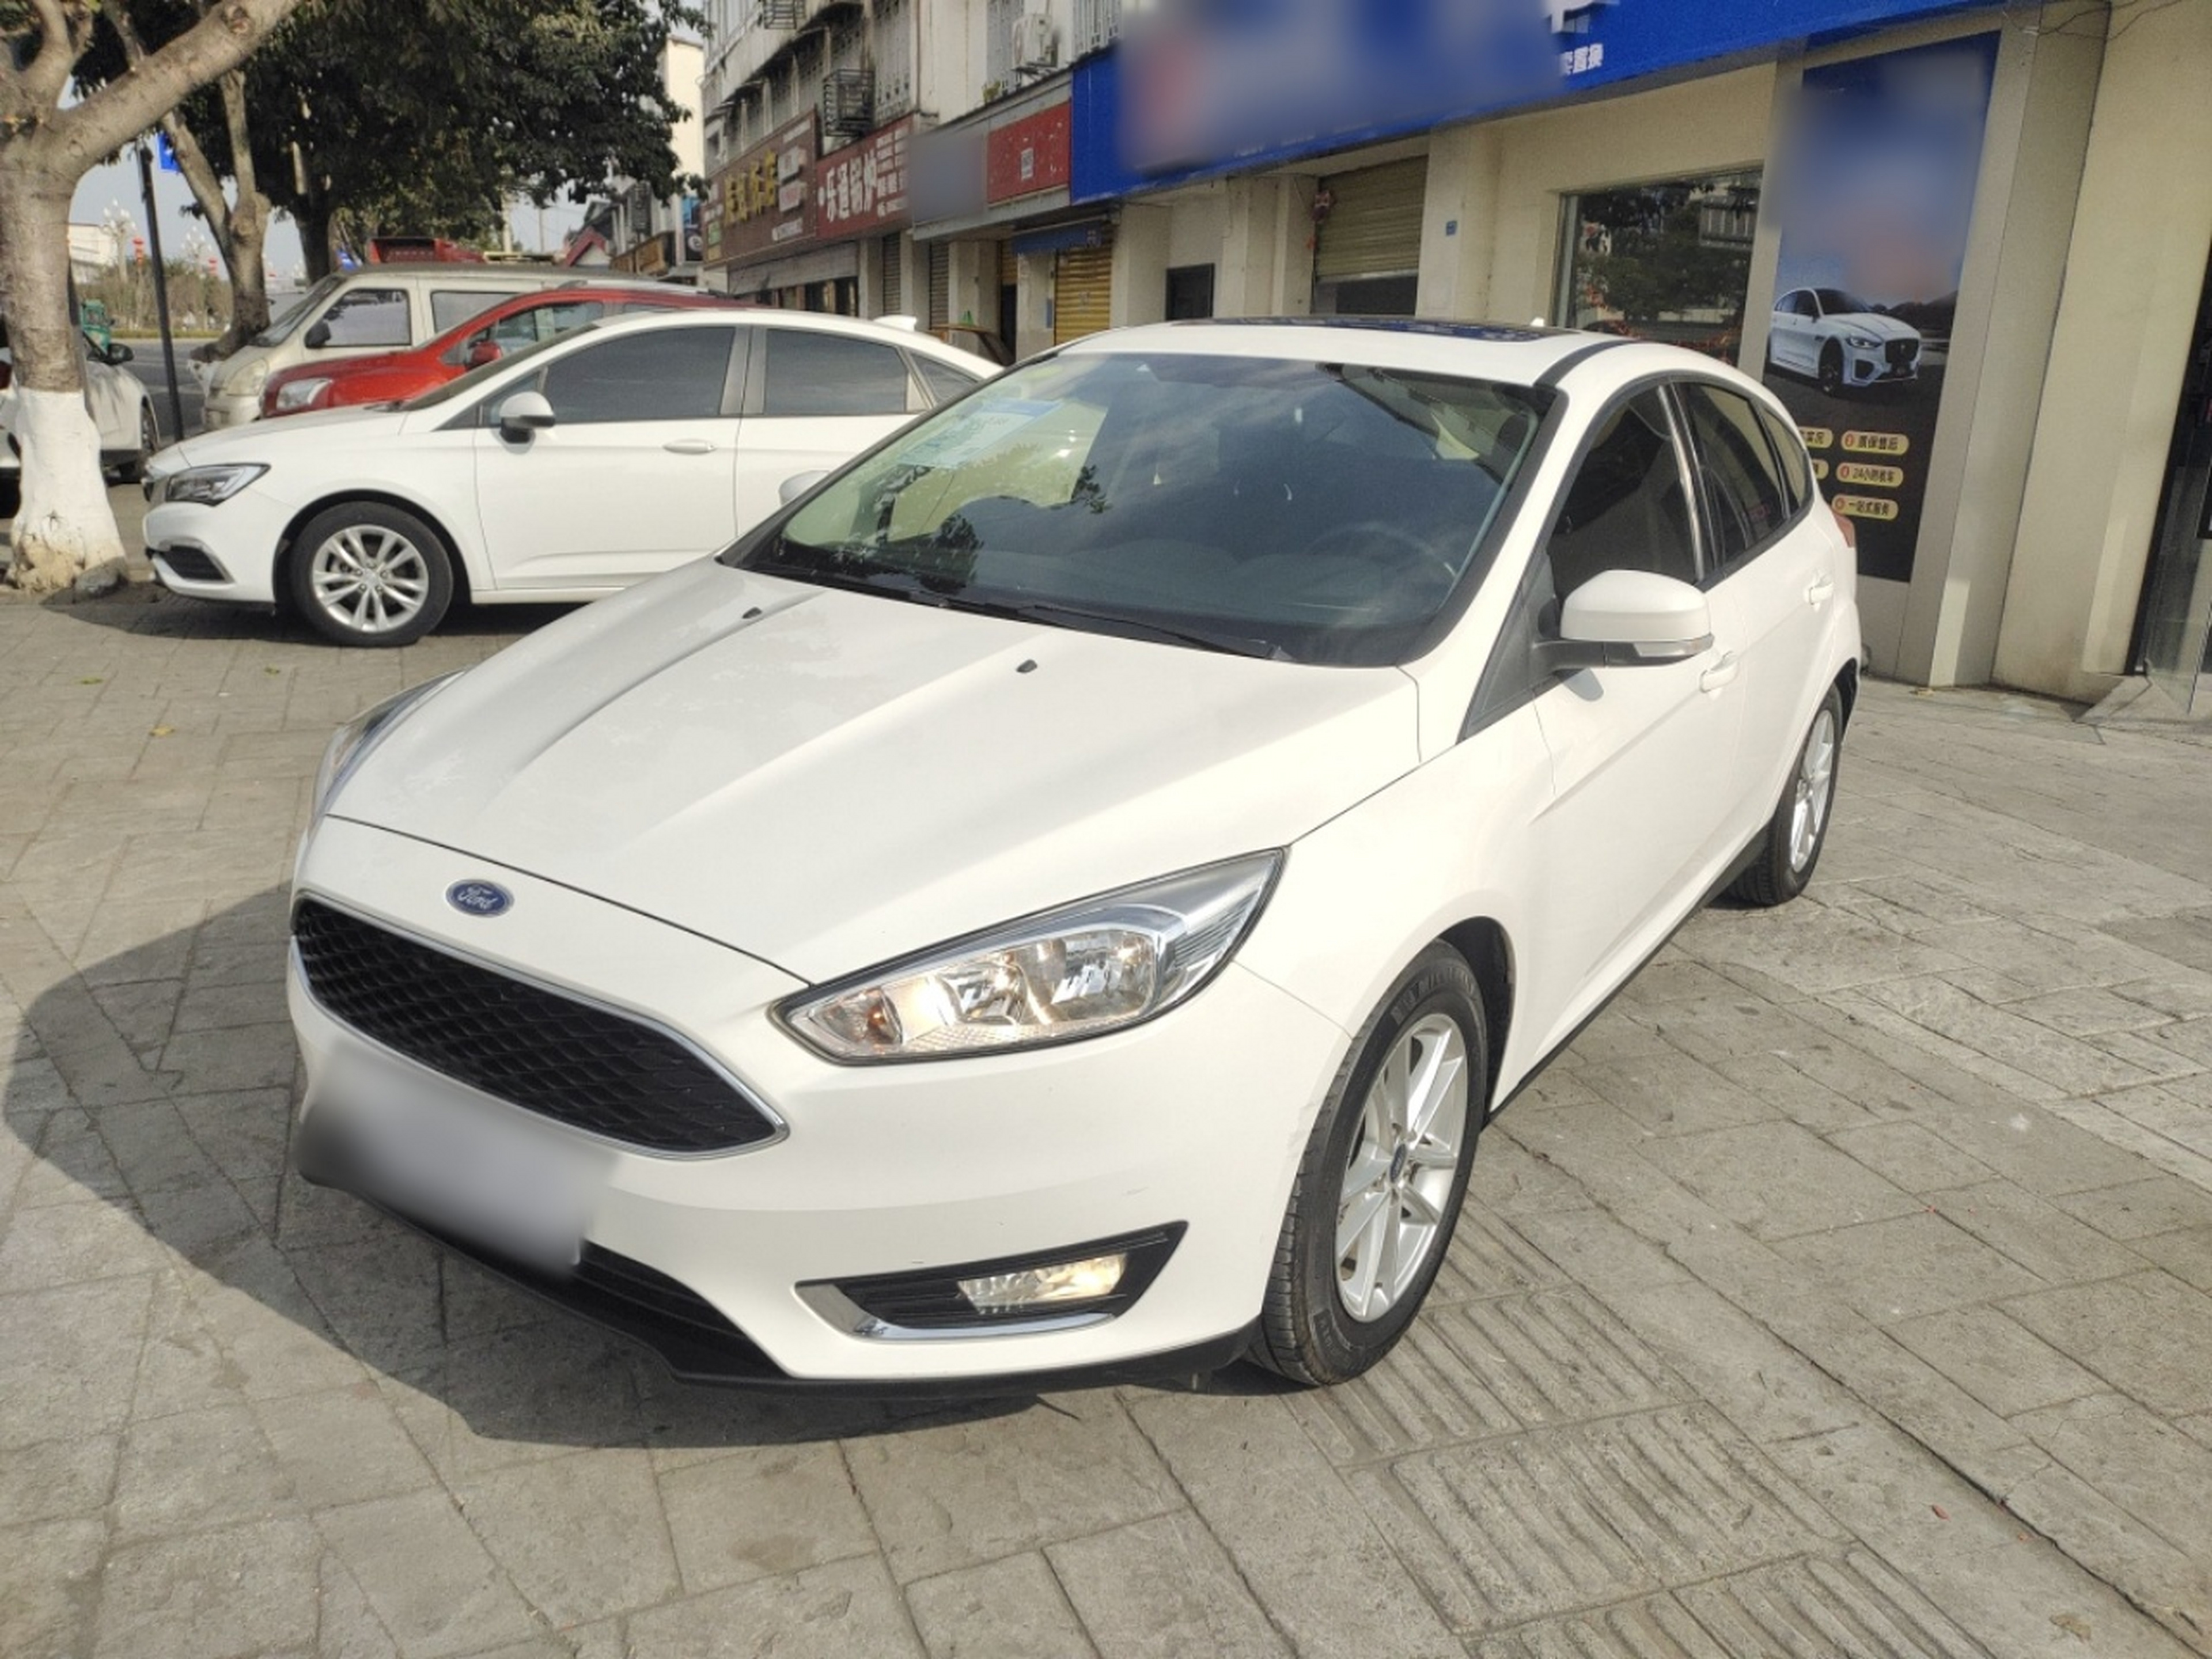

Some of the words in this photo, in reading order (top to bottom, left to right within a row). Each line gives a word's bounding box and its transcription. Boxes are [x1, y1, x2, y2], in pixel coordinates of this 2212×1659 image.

[1849, 500, 1889, 516] 一站式服务
[457, 886, 499, 910] Ford
